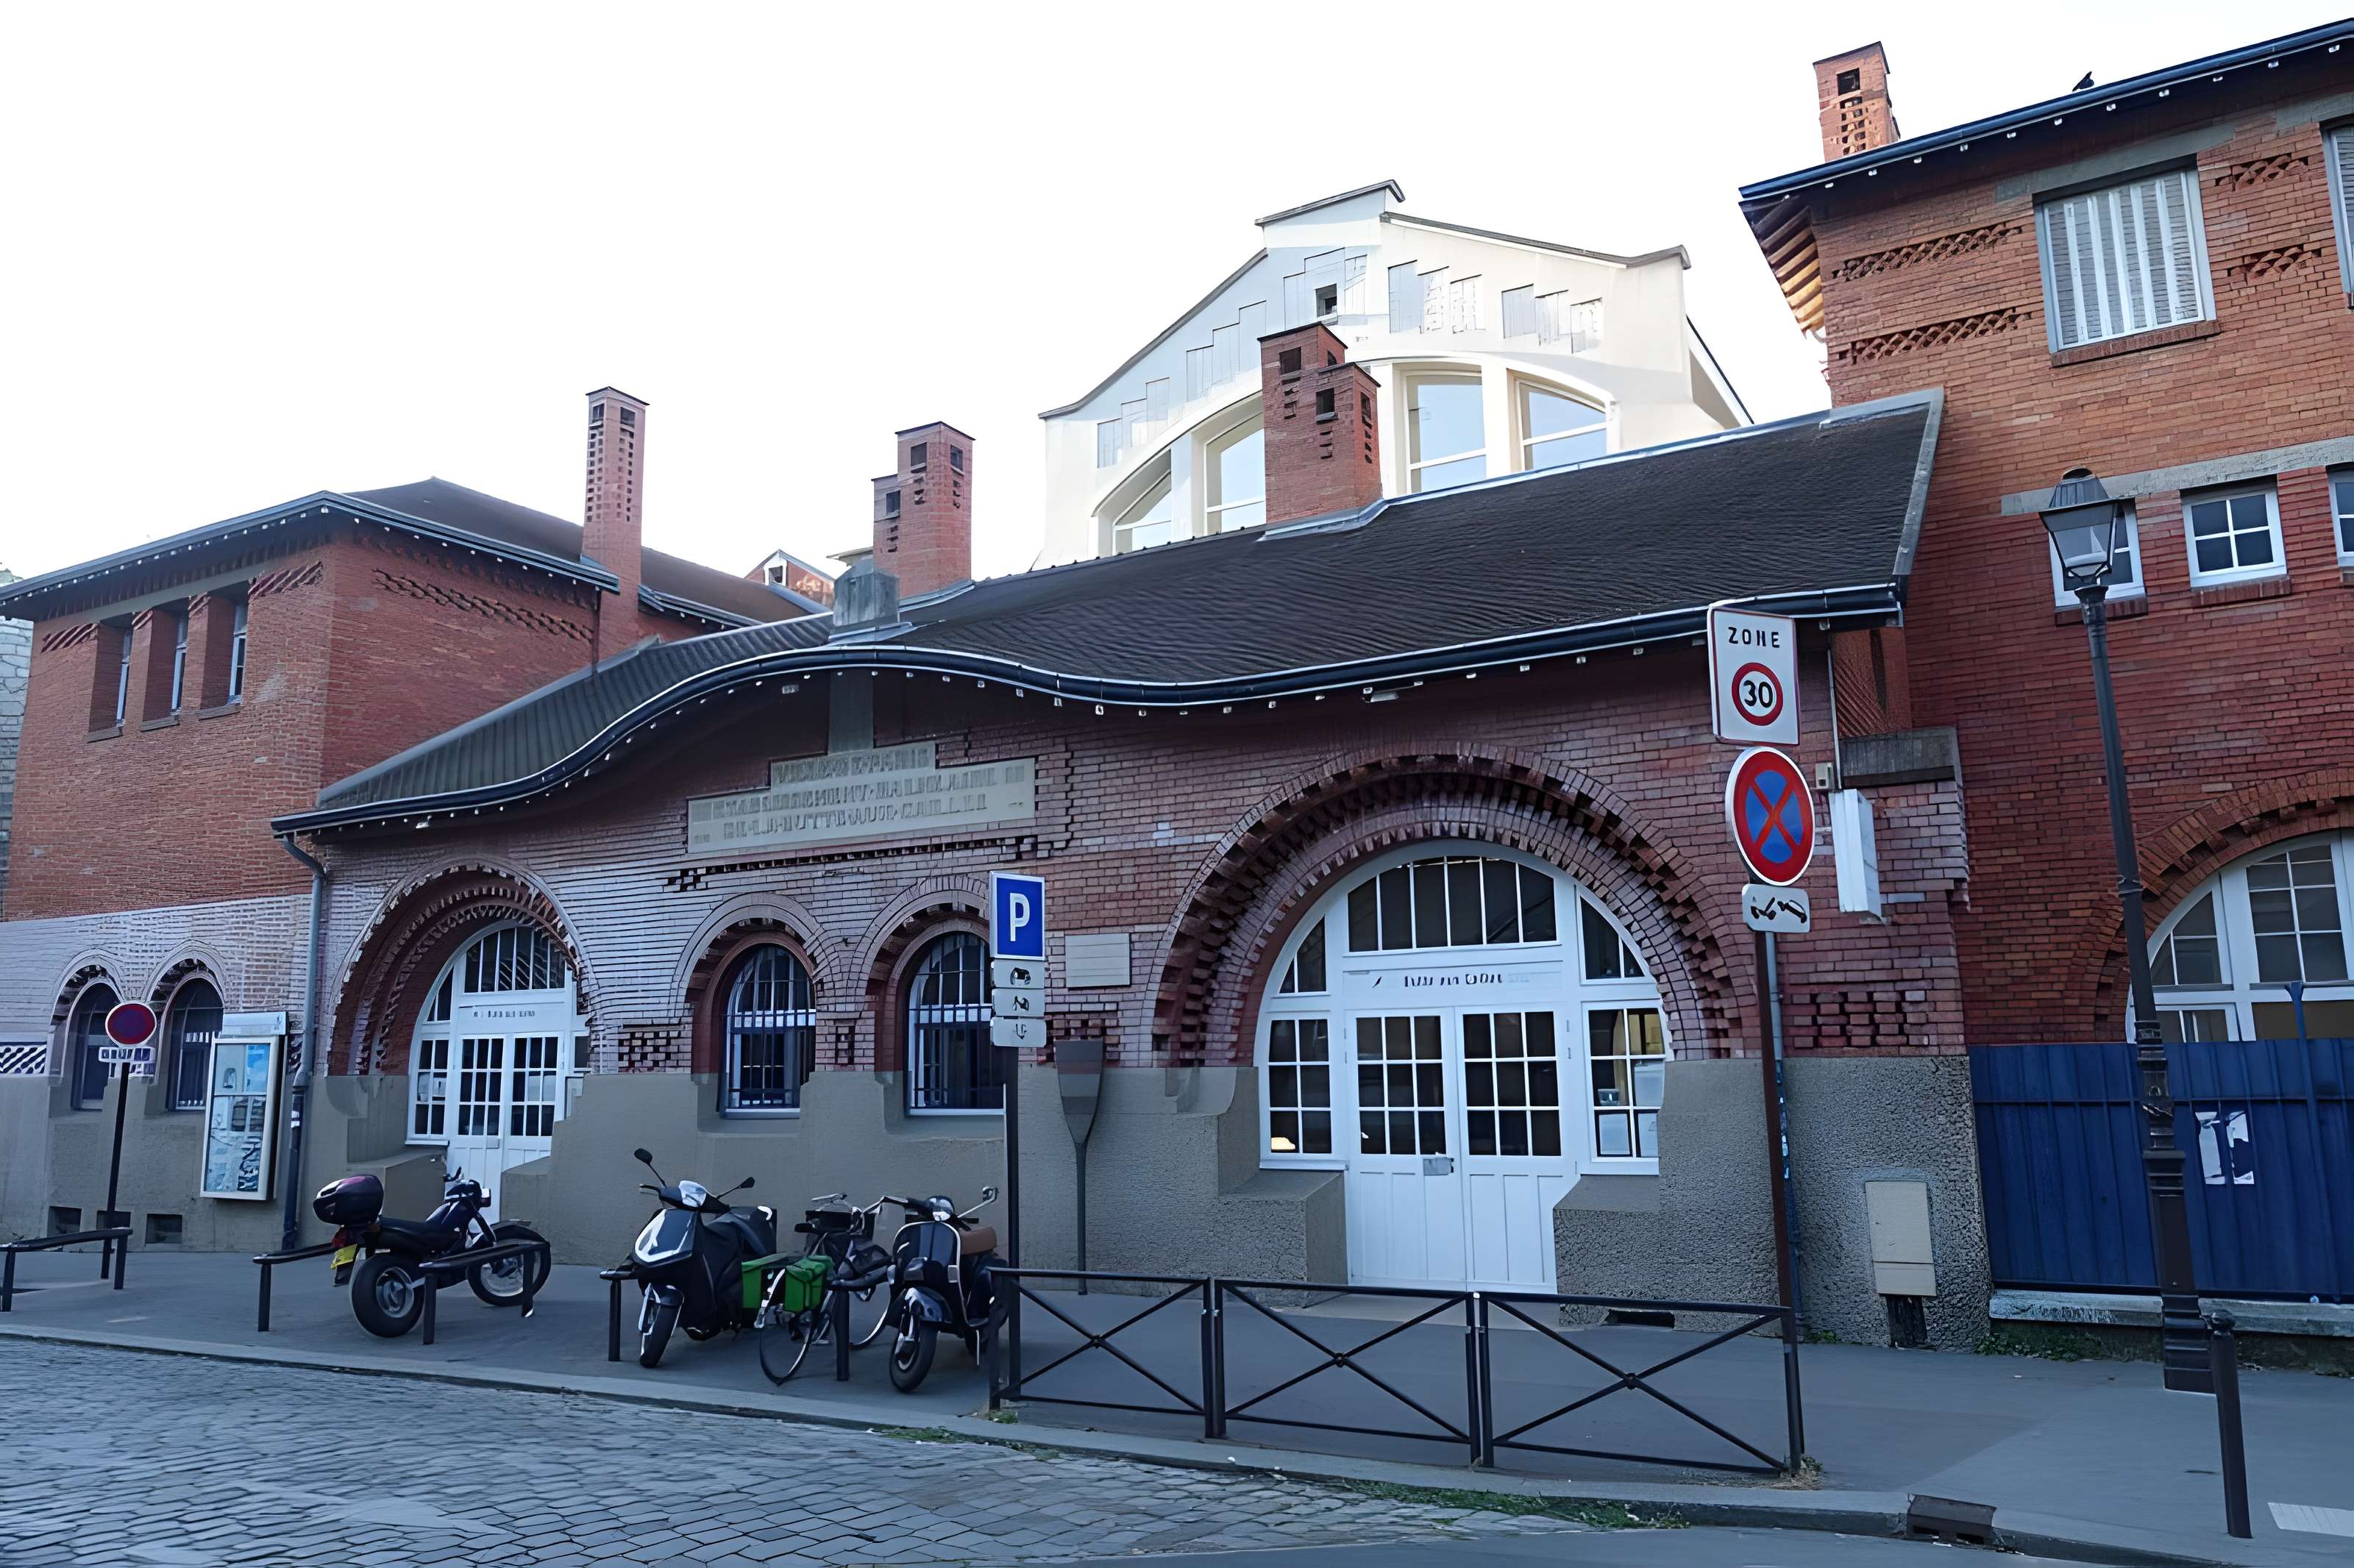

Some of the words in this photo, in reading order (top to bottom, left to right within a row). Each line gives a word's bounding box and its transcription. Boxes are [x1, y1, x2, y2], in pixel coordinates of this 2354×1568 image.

[1728, 627, 1780, 649] ZONE
[1743, 680, 1774, 708] 30
[1009, 892, 1031, 942] P
